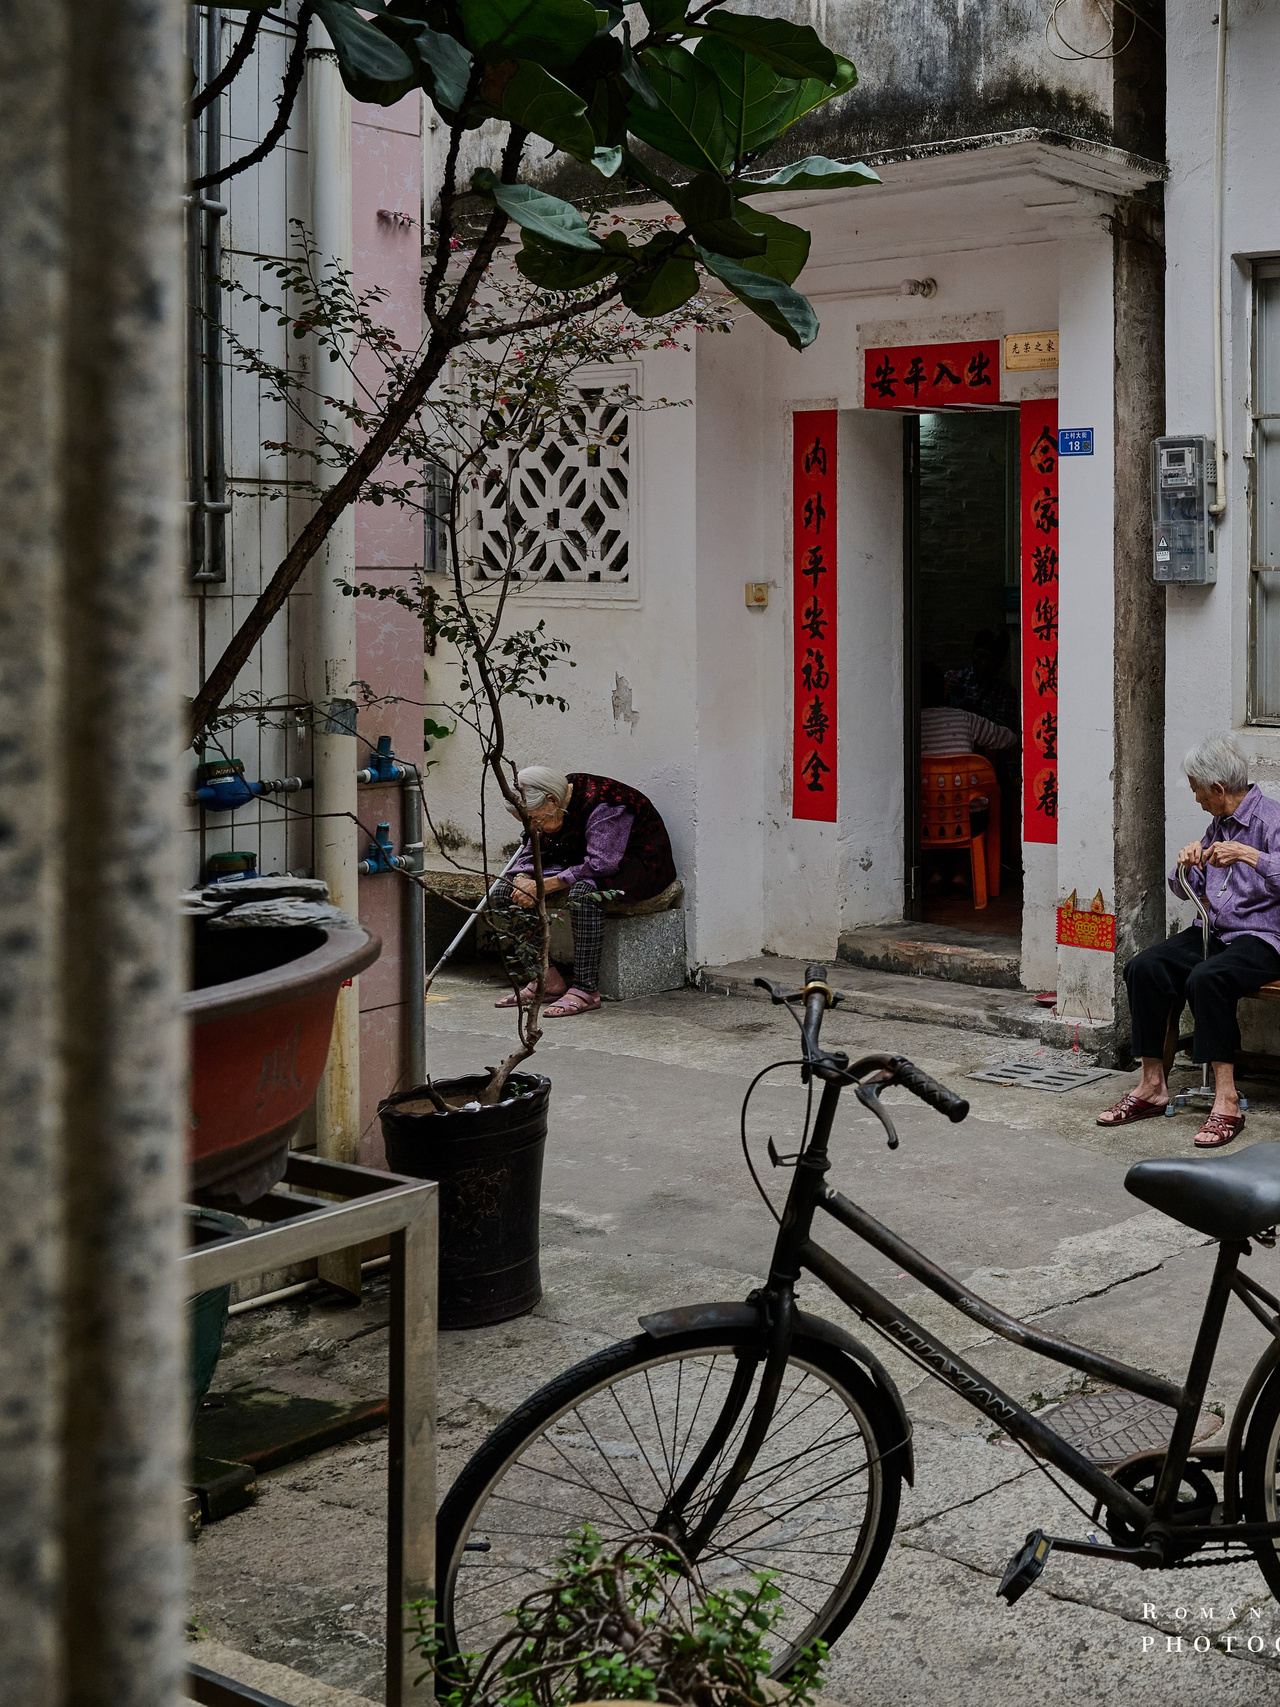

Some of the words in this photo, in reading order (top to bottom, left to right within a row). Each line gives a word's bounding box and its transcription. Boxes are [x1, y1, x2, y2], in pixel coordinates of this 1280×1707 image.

[1064, 432, 1088, 440] 上村大街
[1068, 441, 1081, 451] 18
[884, 1320, 1018, 1420] HUAXIAN
